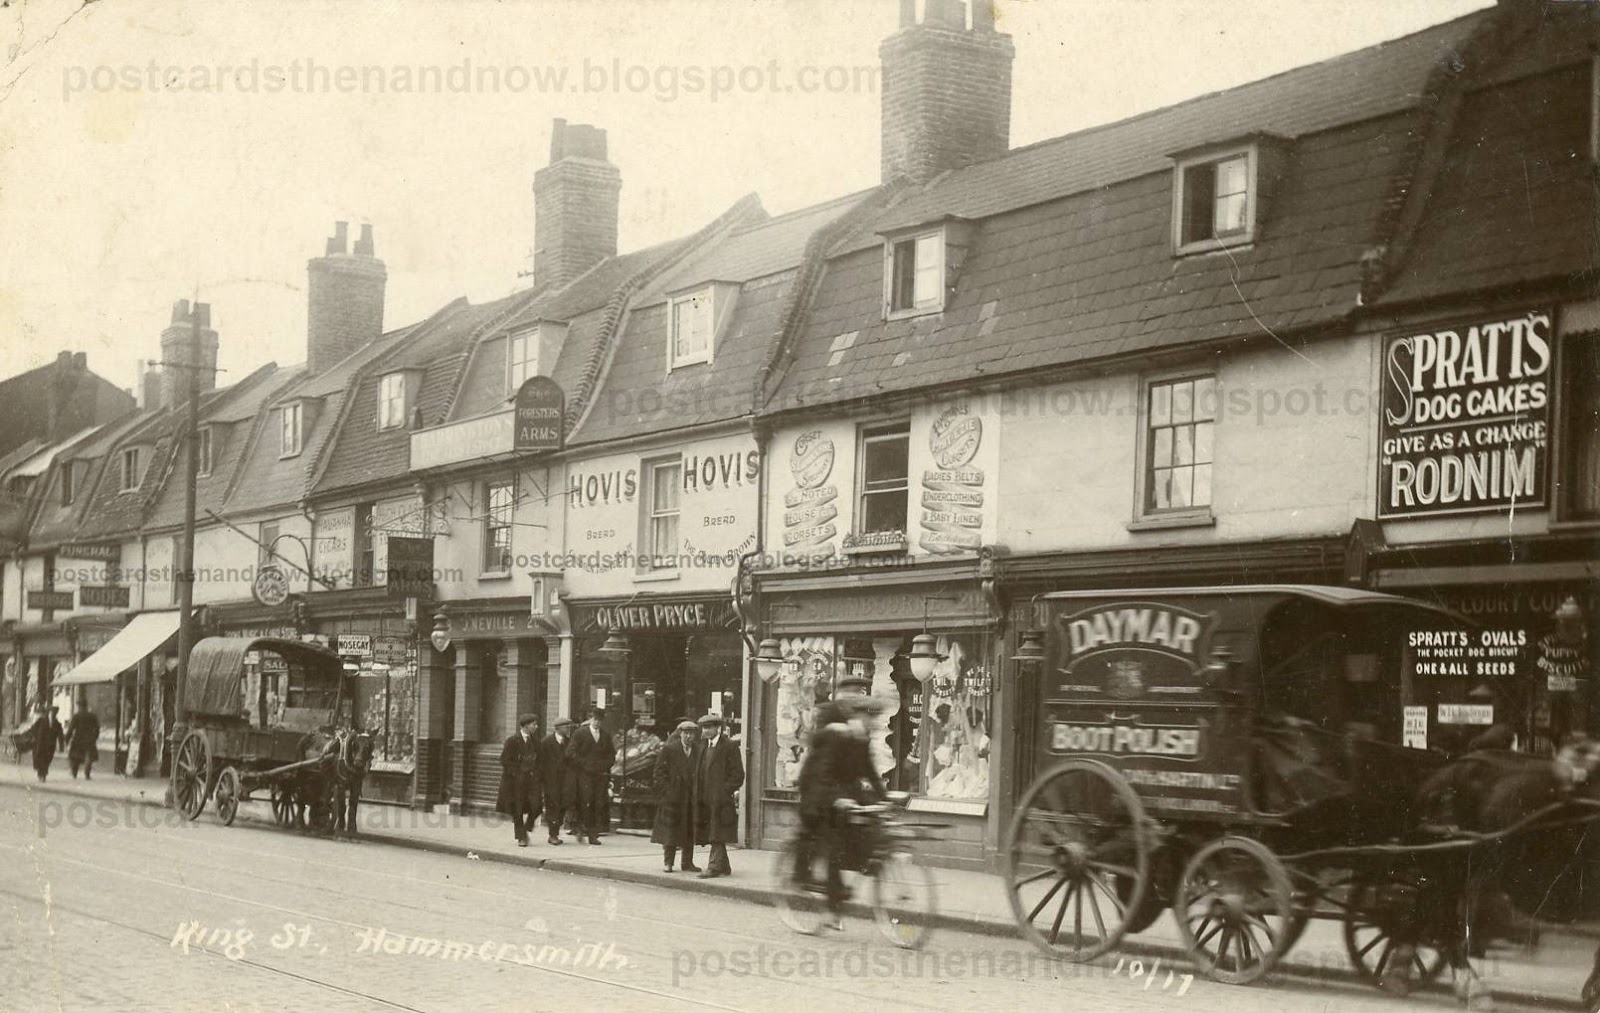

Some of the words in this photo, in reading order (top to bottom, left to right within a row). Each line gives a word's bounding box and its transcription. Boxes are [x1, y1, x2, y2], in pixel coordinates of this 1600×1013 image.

[1385, 313, 1549, 426] SPRATT'S
[1415, 393, 1462, 423] DOG
[1466, 382, 1547, 417] CAKES
[519, 427, 558, 441] ARMS
[1383, 435, 1425, 456] GIVE
[1430, 431, 1454, 452] AS
[1458, 430, 1471, 447] A
[1475, 421, 1546, 446] CHANGE
[683, 450, 760, 491] HOVIS
[924, 471, 952, 482] LADIES
[955, 471, 980, 483] BELTS
[570, 469, 637, 506] HOVIS
[923, 491, 981, 503] UNDERCLOTHING
[930, 512, 950, 522] BABY
[953, 513, 980, 524] LINEN
[784, 525, 832, 542] CORSETS
[597, 607, 650, 630] OLIVER
[654, 603, 706, 628] PRYCE
[1068, 608, 1200, 654] DAYMAR
[1409, 631, 1468, 647] SPRATT'S
[1481, 630, 1527, 646] OVALS
[338, 640, 369, 650] NOSEGAY
[1417, 648, 1431, 658] THE
[1434, 648, 1463, 658] POCKET
[1468, 647, 1485, 657] DOG
[1488, 647, 1518, 657] BISCUIT
[264, 659, 287, 669] SAL
[1477, 662, 1516, 675] SEEDS
[1053, 724, 1114, 752] BOOT
[1114, 726, 1200, 755] POLISH
